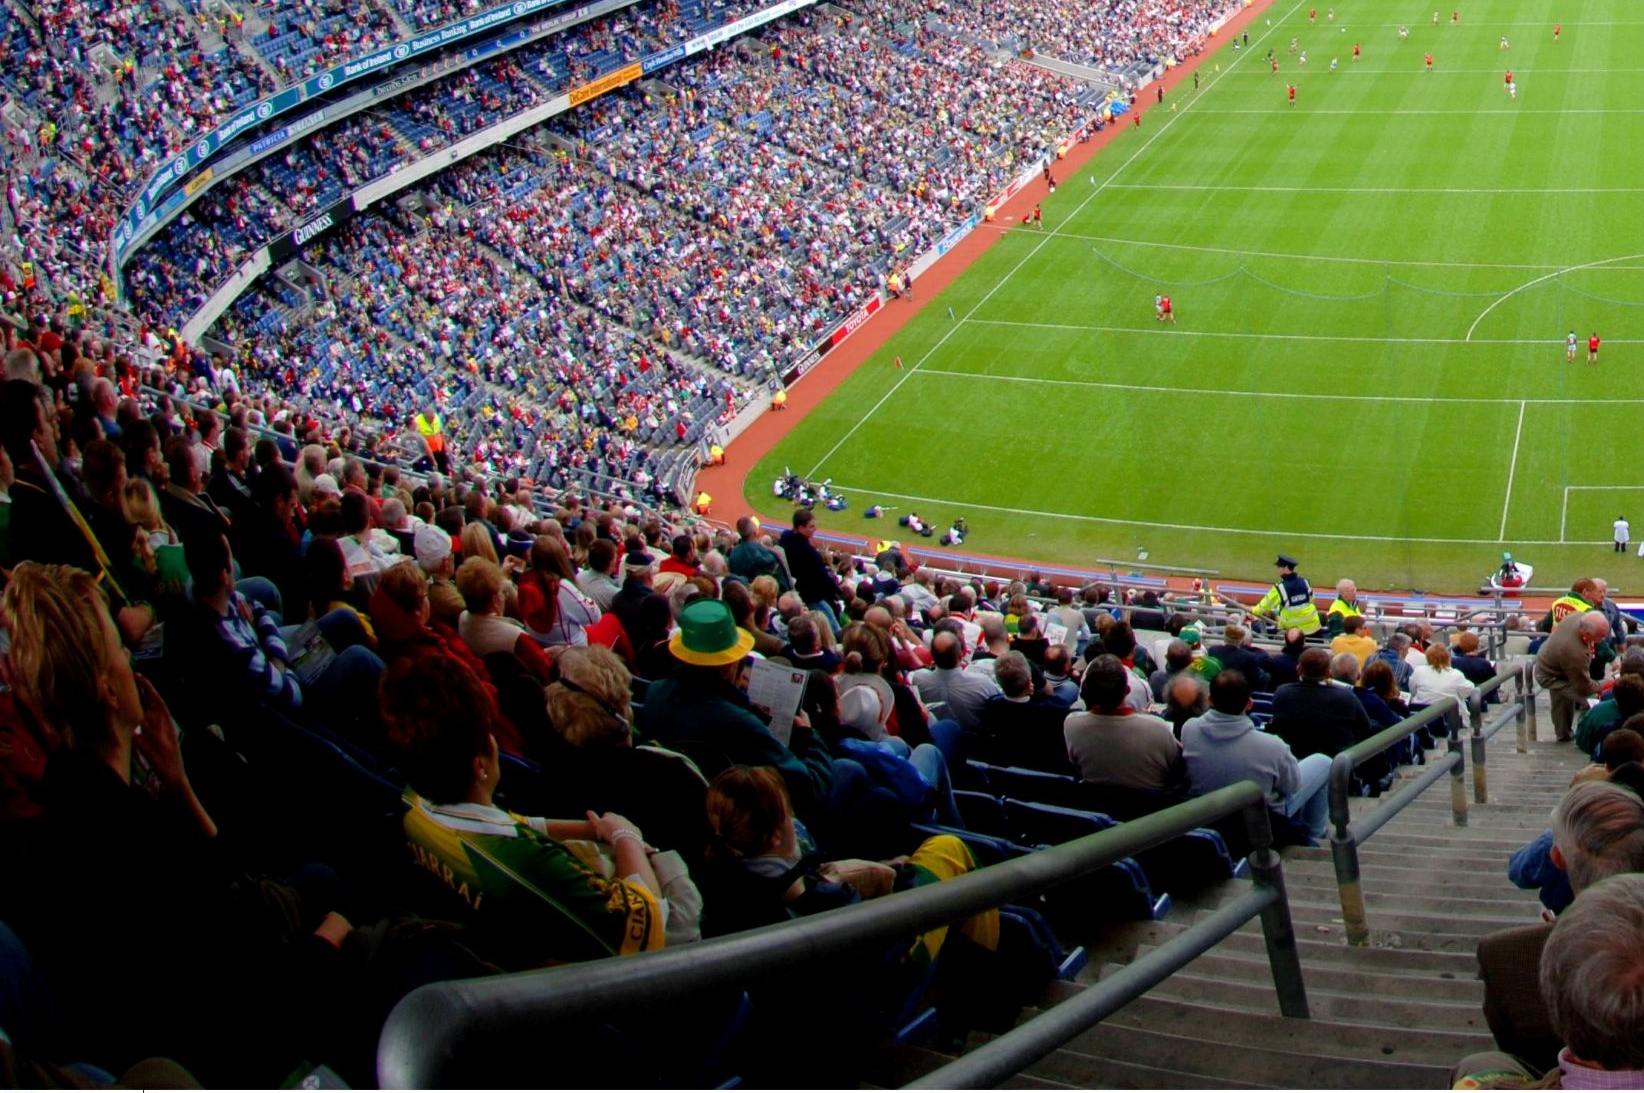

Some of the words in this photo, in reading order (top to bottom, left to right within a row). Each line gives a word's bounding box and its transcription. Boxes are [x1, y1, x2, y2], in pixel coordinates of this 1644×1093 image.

[469, 17, 485, 30] Bank
[490, 8, 511, 21] Ireland
[411, 34, 441, 51] Business
[440, 25, 467, 41] Banking
[345, 63, 363, 76] Bank
[367, 52, 392, 67] Ireland
[252, 129, 287, 152] PATRICIA
[294, 212, 333, 245] GUINNESS
[845, 309, 869, 334] TOYOTA
[797, 350, 821, 375] GUINNESS
